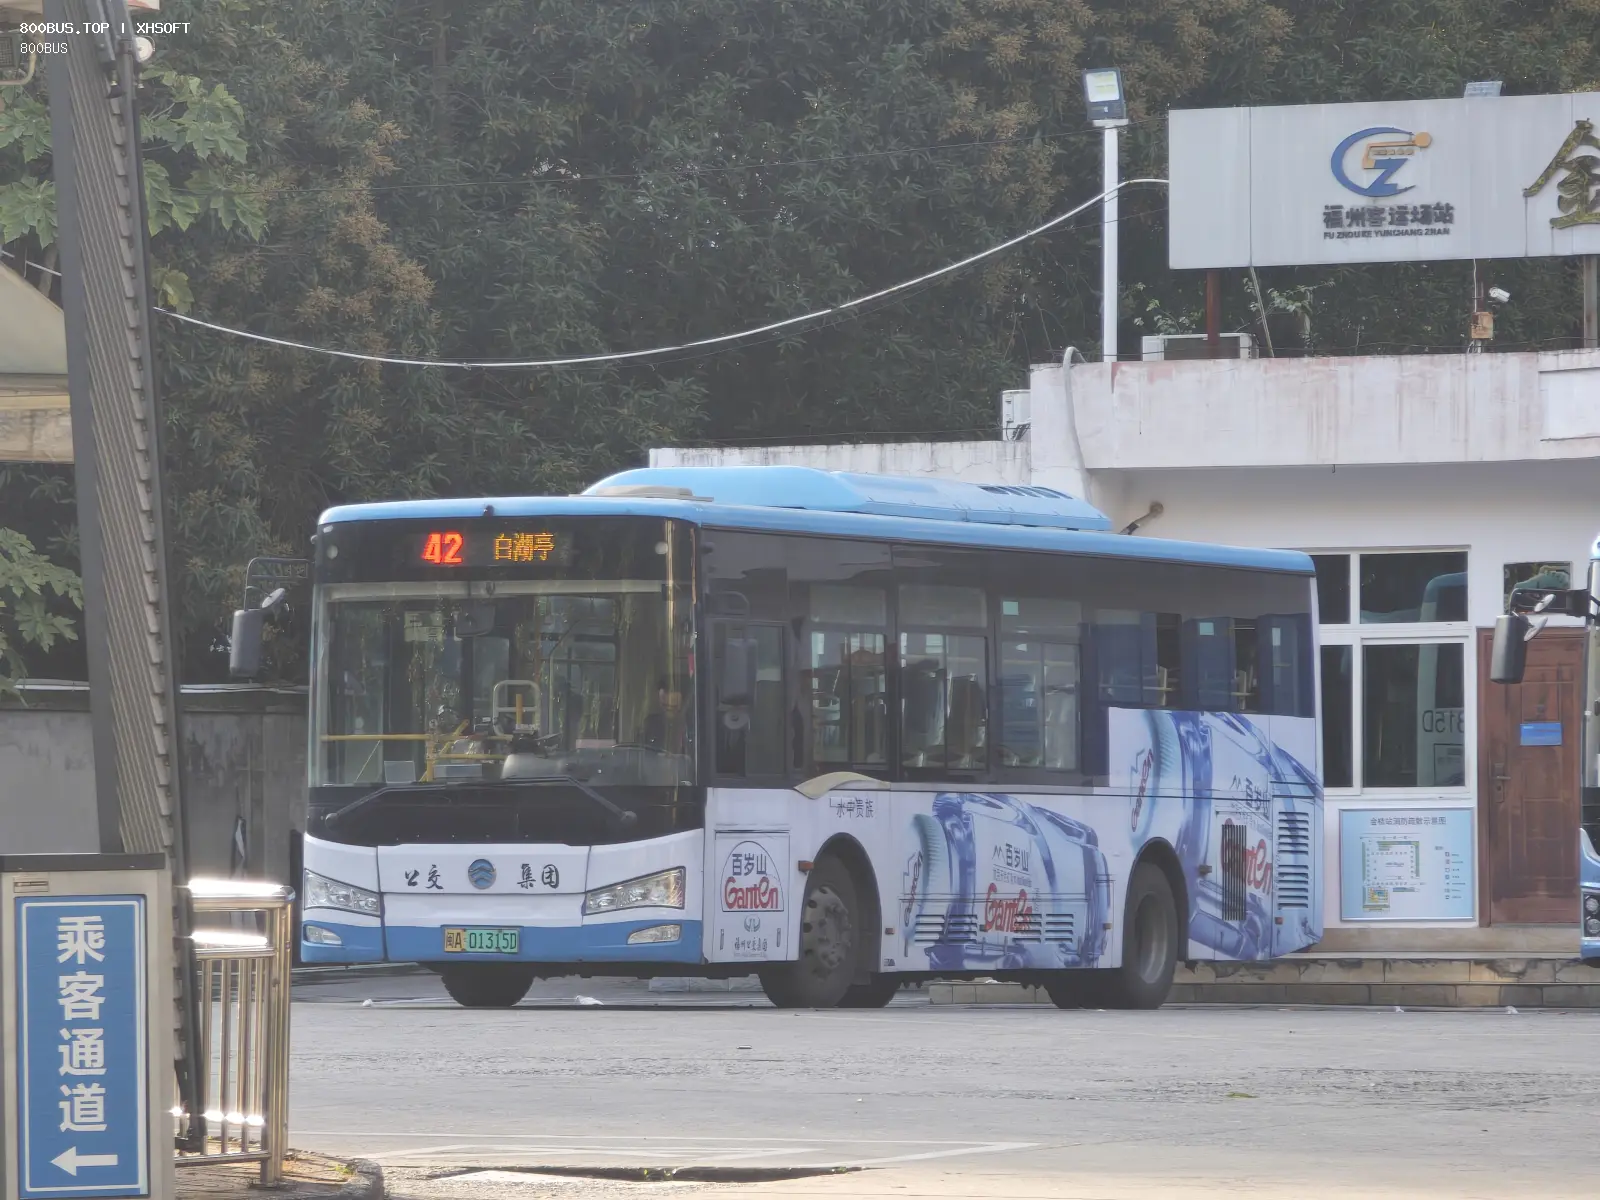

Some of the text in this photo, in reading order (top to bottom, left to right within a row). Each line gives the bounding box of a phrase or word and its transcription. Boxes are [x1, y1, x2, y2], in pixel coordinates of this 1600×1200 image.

[1323, 202, 1455, 229] 福州客运场站
[423, 532, 464, 564] 42
[732, 853, 768, 876] 百岁山
[1005, 842, 1029, 872] 百岁山
[405, 863, 560, 890] 公交 集团
[724, 876, 779, 910] Ganten
[56, 915, 108, 1132] 乘客通道
